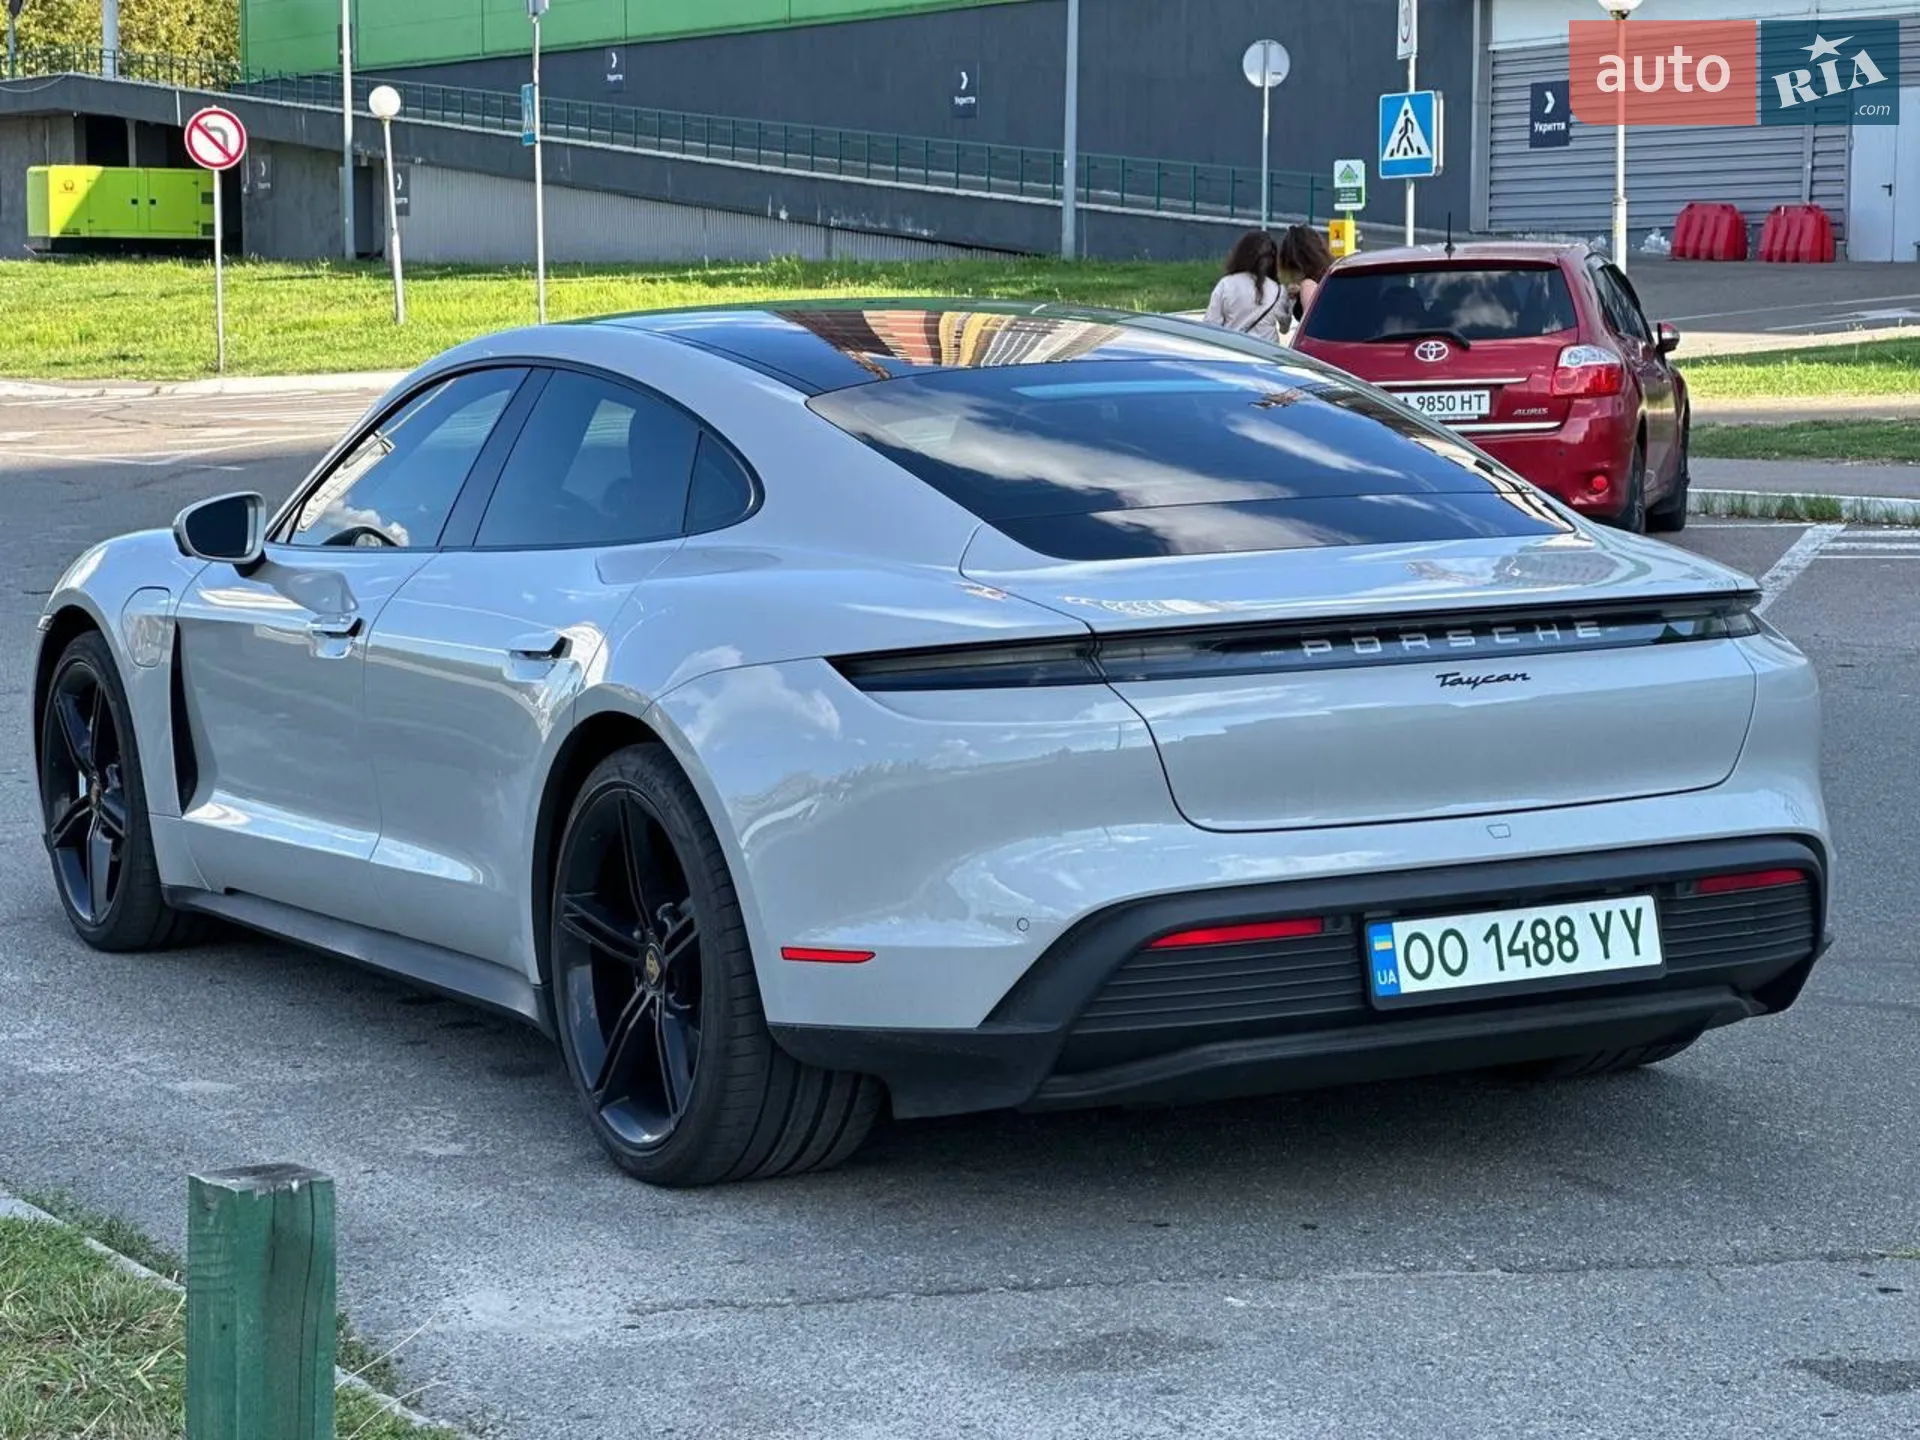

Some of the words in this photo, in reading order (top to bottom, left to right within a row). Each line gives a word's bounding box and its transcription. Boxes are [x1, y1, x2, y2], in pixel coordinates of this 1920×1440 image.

[1416, 395, 1456, 412] 9850
[1460, 394, 1486, 411] HT
[1301, 620, 1601, 658] PORSCHE
[1435, 671, 1531, 690] Taycan
[1403, 928, 1469, 982] OO
[1482, 916, 1579, 972] 1488
[1589, 907, 1643, 960] YY
[1377, 970, 1398, 986] UA
